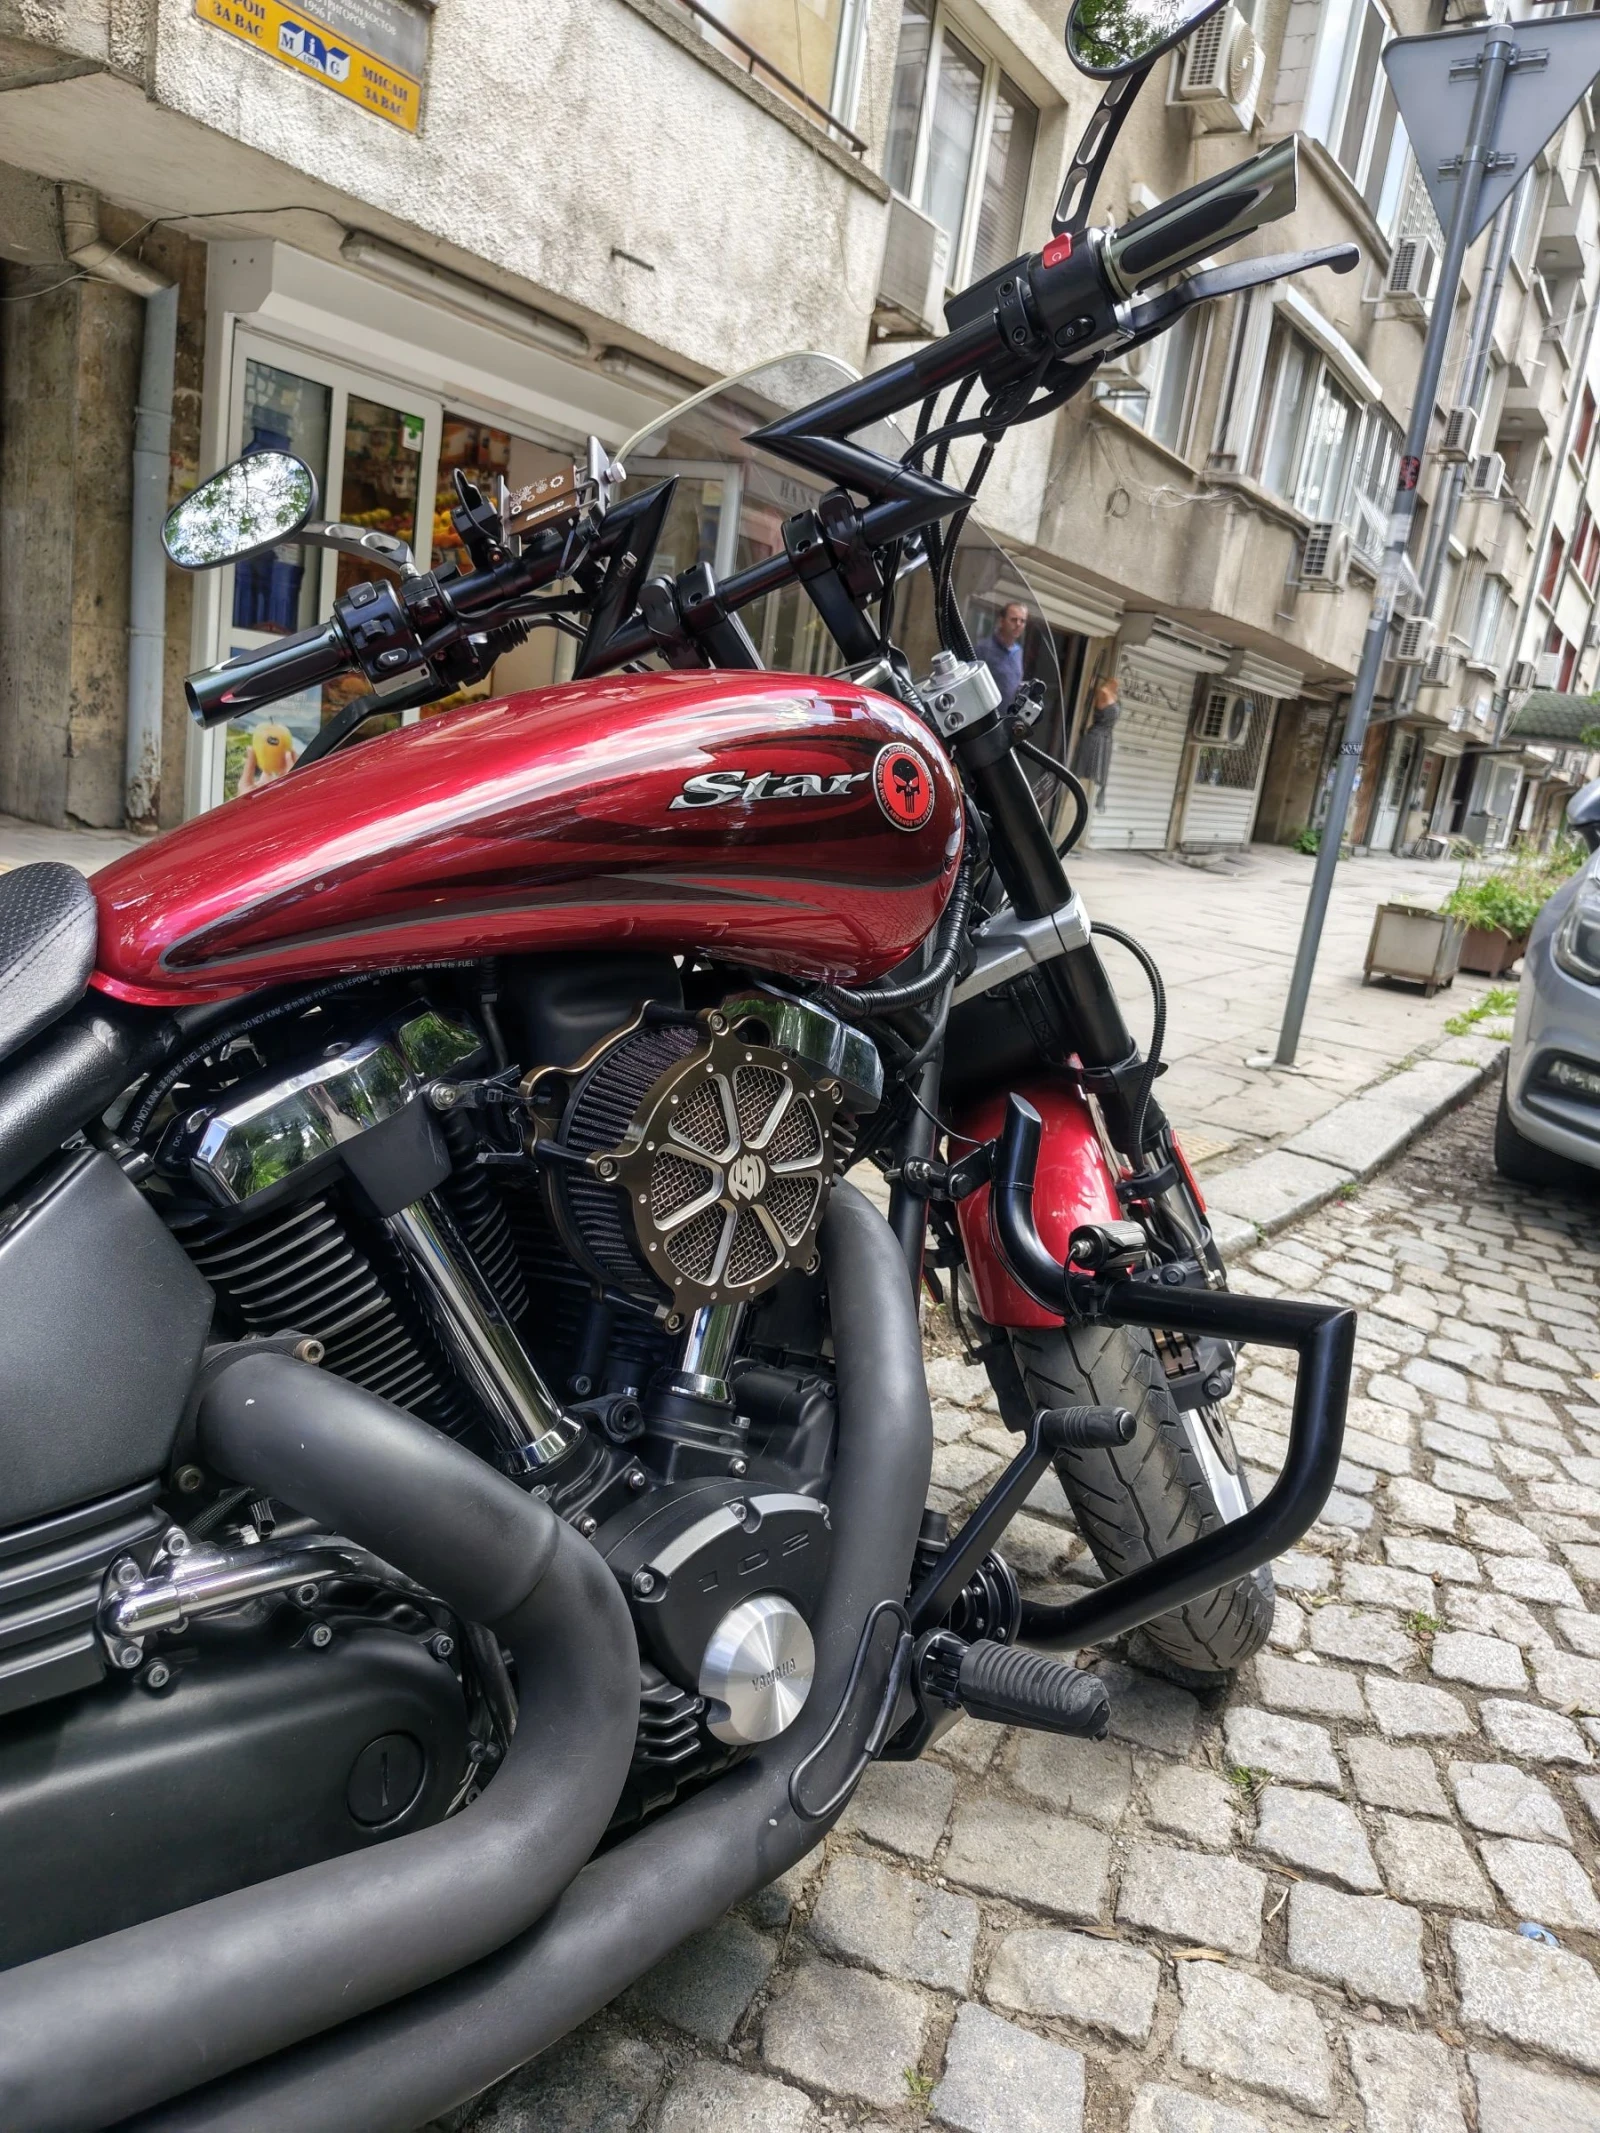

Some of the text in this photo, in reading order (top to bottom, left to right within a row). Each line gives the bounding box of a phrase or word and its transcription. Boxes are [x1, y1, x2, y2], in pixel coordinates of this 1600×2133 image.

[213, 1, 264, 39] ЗА ВАС
[363, 85, 405, 117] ЗА ВАС
[669, 769, 872, 811] Star
[457, 959, 475, 969] FUEL
[131, 1119, 143, 1134] DO
[138, 1104, 150, 1121] NOT
[181, 1052, 201, 1068] FUEL
[751, 1657, 797, 1693] YAMAHA
